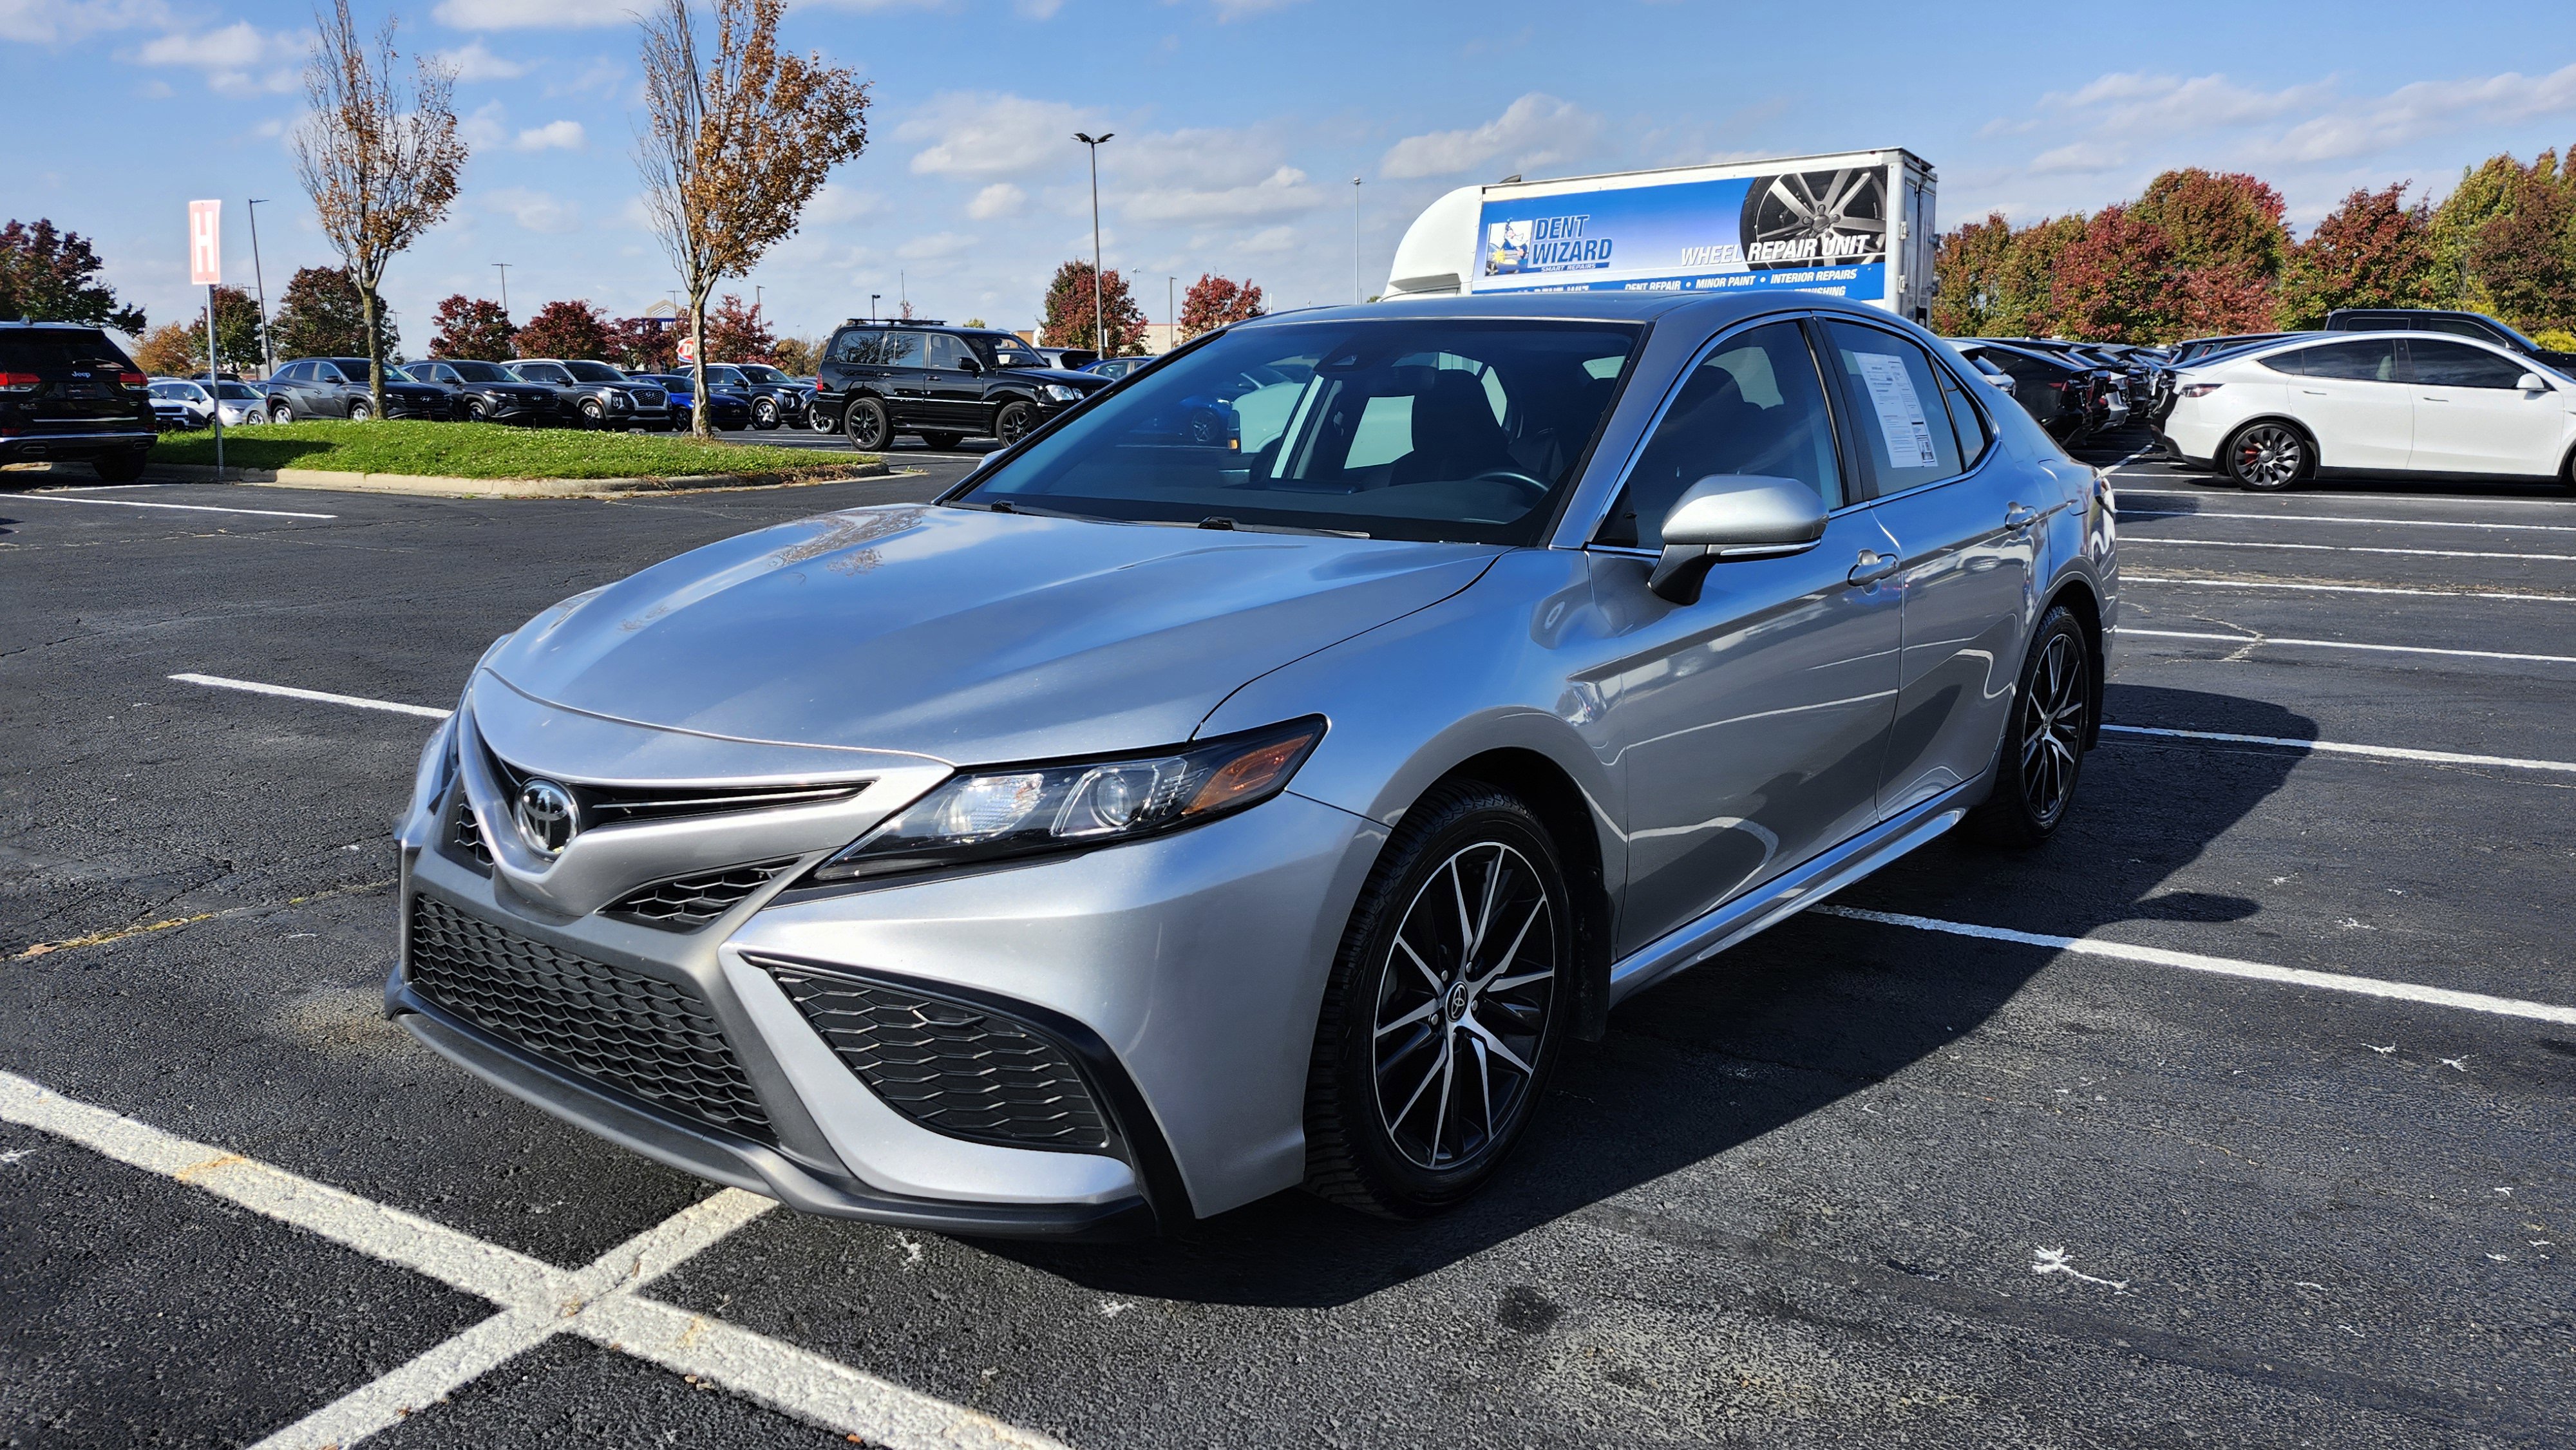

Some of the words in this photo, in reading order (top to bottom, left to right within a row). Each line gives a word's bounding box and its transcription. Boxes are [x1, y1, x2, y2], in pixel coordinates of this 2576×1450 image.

[1534, 214, 1589, 241] DENT
[194, 211, 215, 273] H
[1532, 238, 1613, 265] WIZARD
[1681, 244, 1742, 266] WHEEL
[1747, 238, 1818, 261] REPAIR
[1821, 234, 1870, 257] UNIT
[1649, 280, 1681, 290] REPAIR
[1695, 277, 1727, 289] MINOR
[1727, 275, 1756, 287] PAINT
[1770, 272, 1814, 284] INTERIOR
[1815, 269, 1857, 282] REPAIRS
